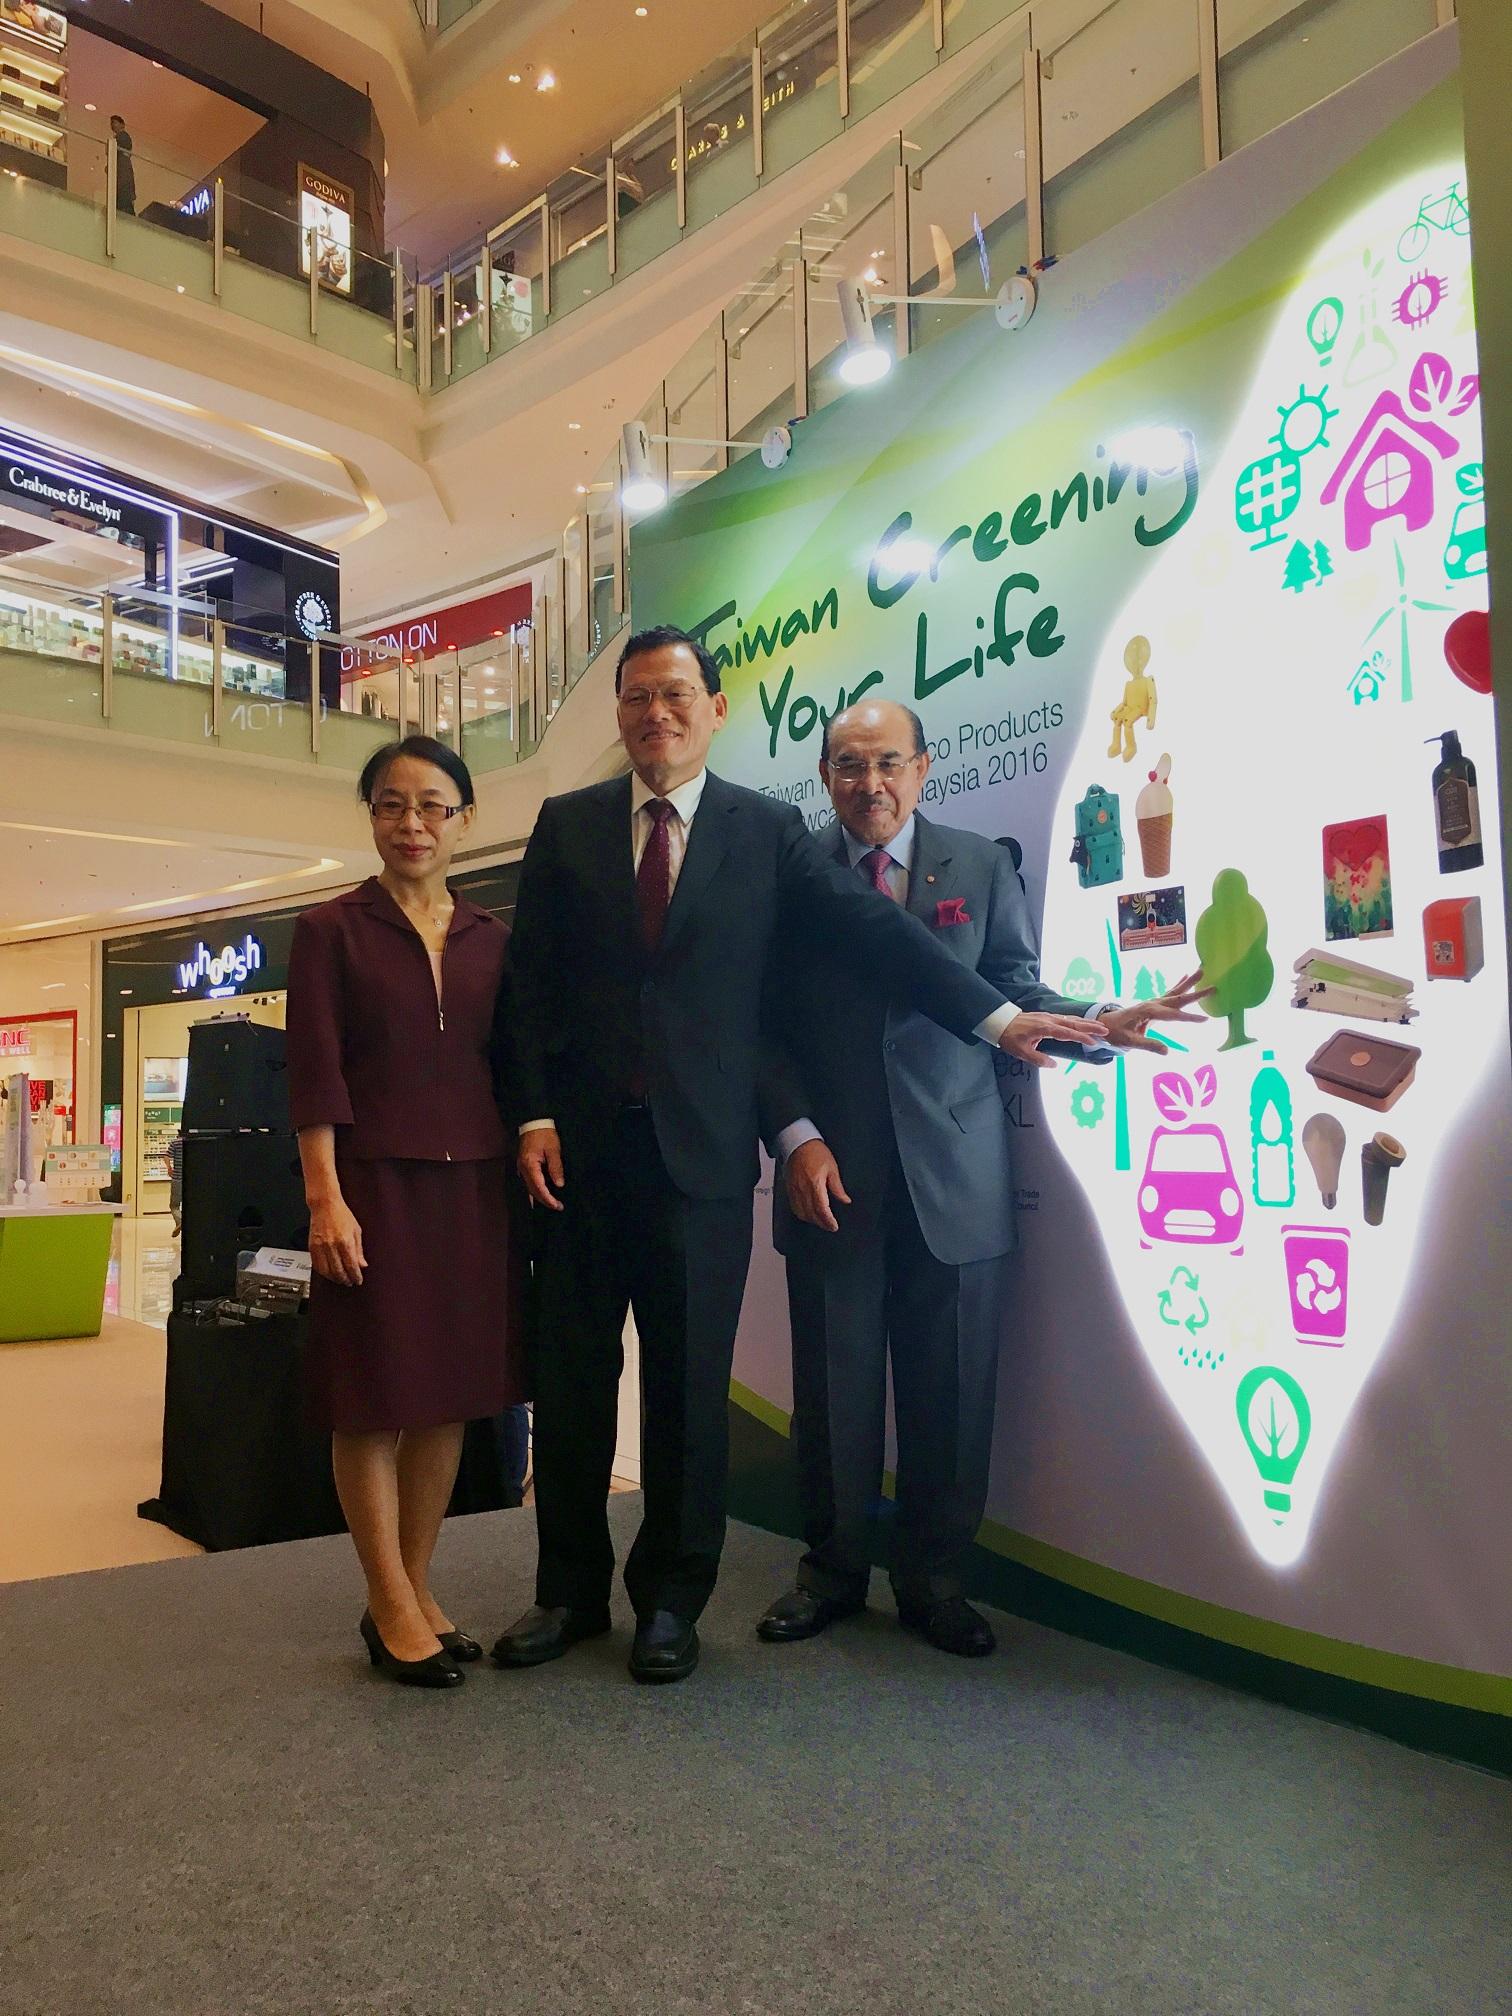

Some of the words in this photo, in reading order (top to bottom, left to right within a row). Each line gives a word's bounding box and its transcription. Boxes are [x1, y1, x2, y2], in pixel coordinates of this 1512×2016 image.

[763, 81, 795, 112] EITH
[180, 188, 210, 216] DIVA
[305, 176, 346, 204] GODIVA
[867, 429, 1199, 609] Greening
[340, 630, 403, 671] OTTON
[408, 619, 437, 651] ON
[914, 572, 1066, 701] Life
[926, 737, 951, 764] co
[958, 701, 1064, 755] Products
[917, 763, 981, 806] laysia
[988, 741, 1048, 786] 2016
[179, 934, 261, 989] whoosh
[1065, 977, 1096, 997] CO2
[0, 1027, 32, 1048] NC
